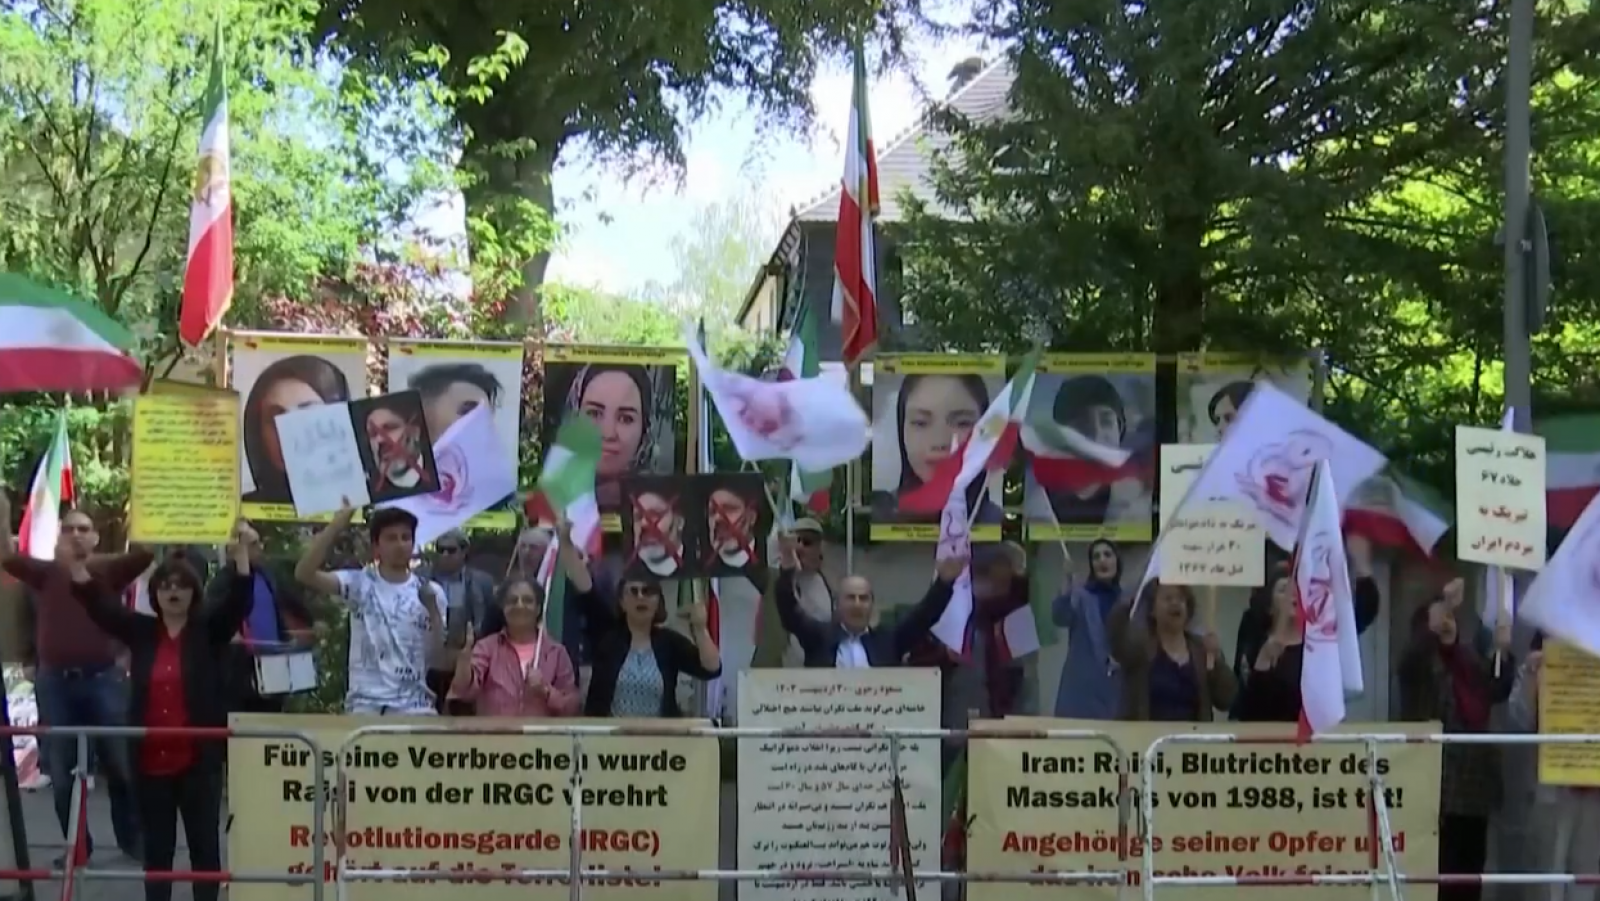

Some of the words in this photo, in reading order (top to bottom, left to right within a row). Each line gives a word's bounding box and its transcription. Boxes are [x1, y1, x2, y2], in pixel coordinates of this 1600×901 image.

[263, 743, 311, 767] Für
[597, 749, 687, 773] wurde
[1021, 752, 1085, 774] Iran:
[1093, 752, 1173, 779] Rii,
[1181, 752, 1332, 775] Blutrichter
[1339, 753, 1390, 775] des
[283, 779, 356, 803] Raii
[365, 785, 417, 804] von
[425, 781, 475, 804] der
[482, 782, 554, 806] IRGC
[562, 784, 669, 808] verehrt
[1006, 786, 1159, 808] Massaks
[1166, 791, 1217, 808] von
[1226, 786, 1304, 814] 1988,
[1312, 786, 1348, 809] ist
[1355, 786, 1404, 809] tt!
[569, 829, 660, 857] IRGC)
[1001, 829, 1164, 858] Angehörge
[1170, 830, 1261, 853] seiner
[1268, 830, 1347, 858] Opfer
[1354, 830, 1405, 853] ud
